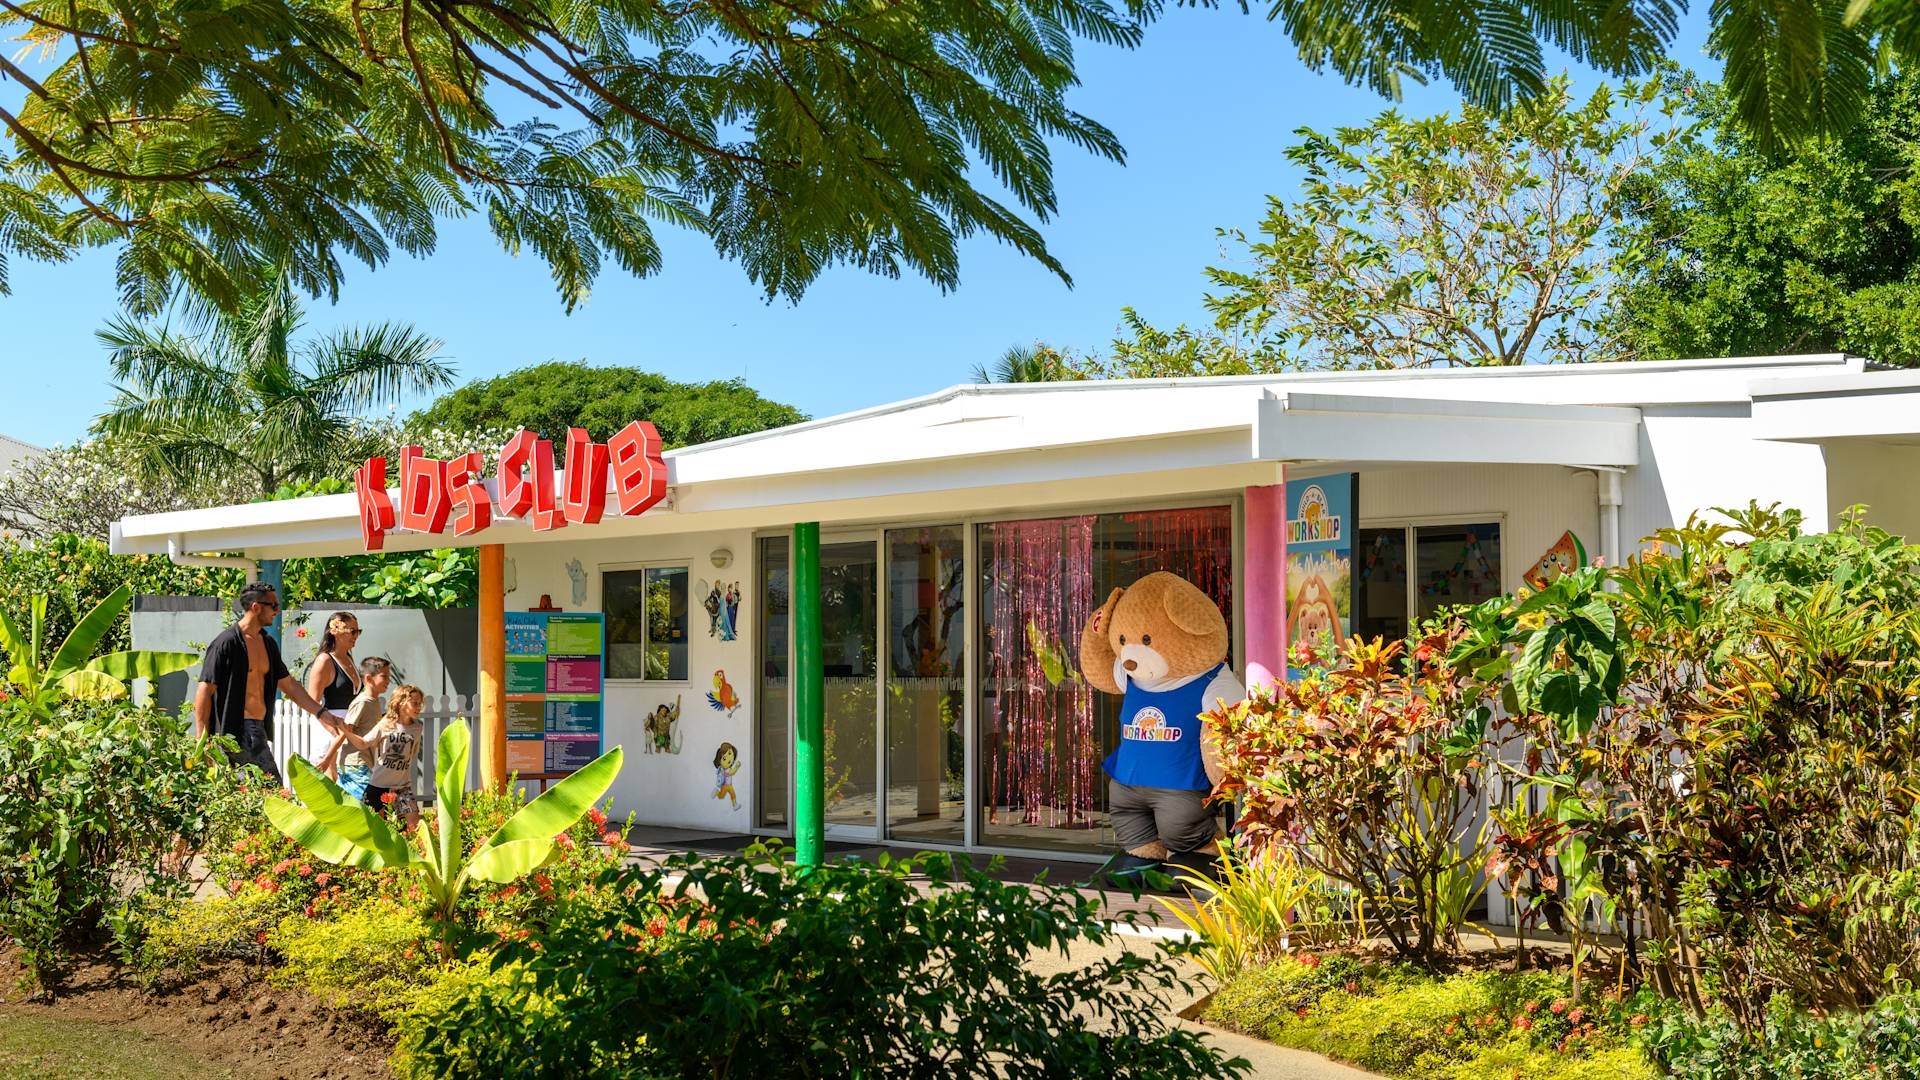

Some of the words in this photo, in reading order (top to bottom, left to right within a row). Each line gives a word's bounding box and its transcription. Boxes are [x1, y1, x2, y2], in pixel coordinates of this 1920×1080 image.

[354, 445, 490, 551] KIDS
[498, 420, 666, 532] CLUB
[1287, 518, 1340, 543] WORKSHOP
[389, 732, 406, 743] DIG
[382, 759, 396, 769] DIG
